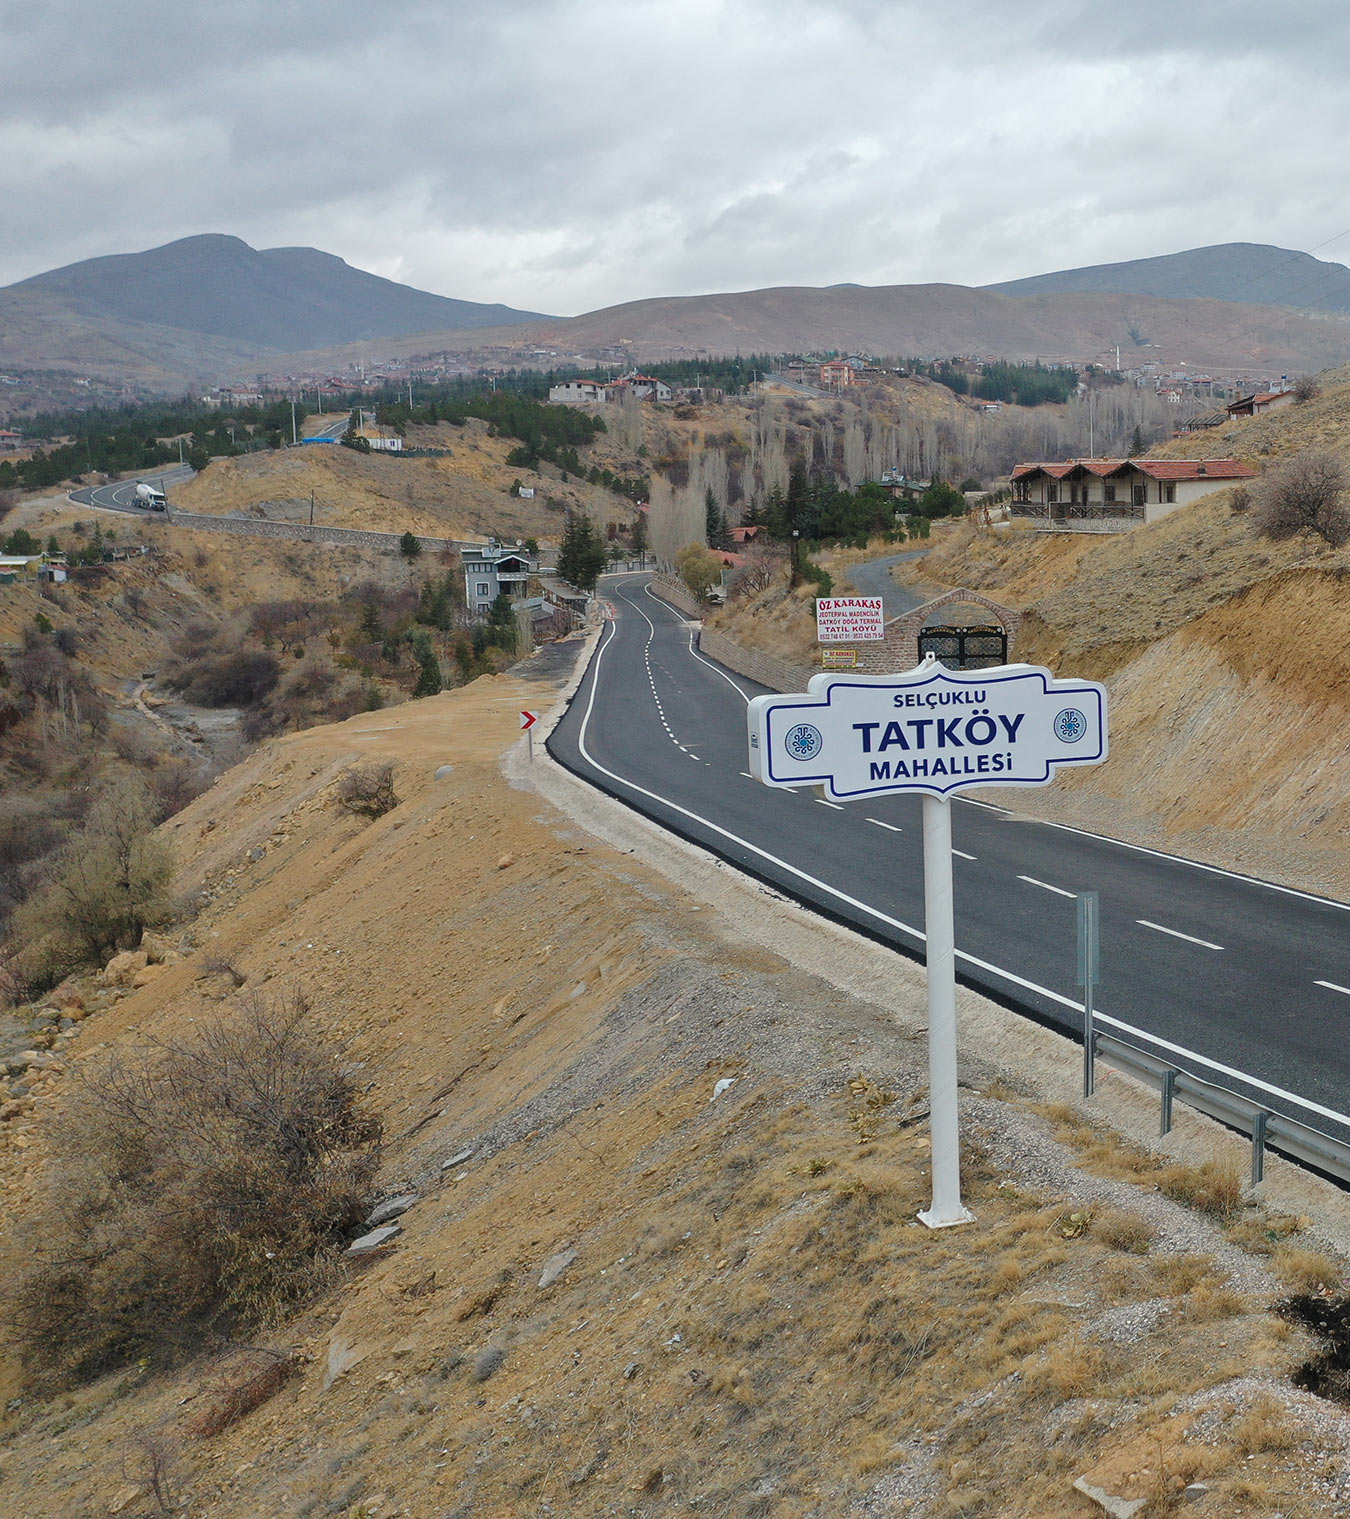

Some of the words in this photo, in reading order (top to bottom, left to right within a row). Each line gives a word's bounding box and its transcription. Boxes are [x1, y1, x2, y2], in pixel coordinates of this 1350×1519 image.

[834, 599, 881, 610] KARAKAŞ
[893, 690, 987, 710] SELÇUKLU
[852, 708, 1025, 753] TATKÖY
